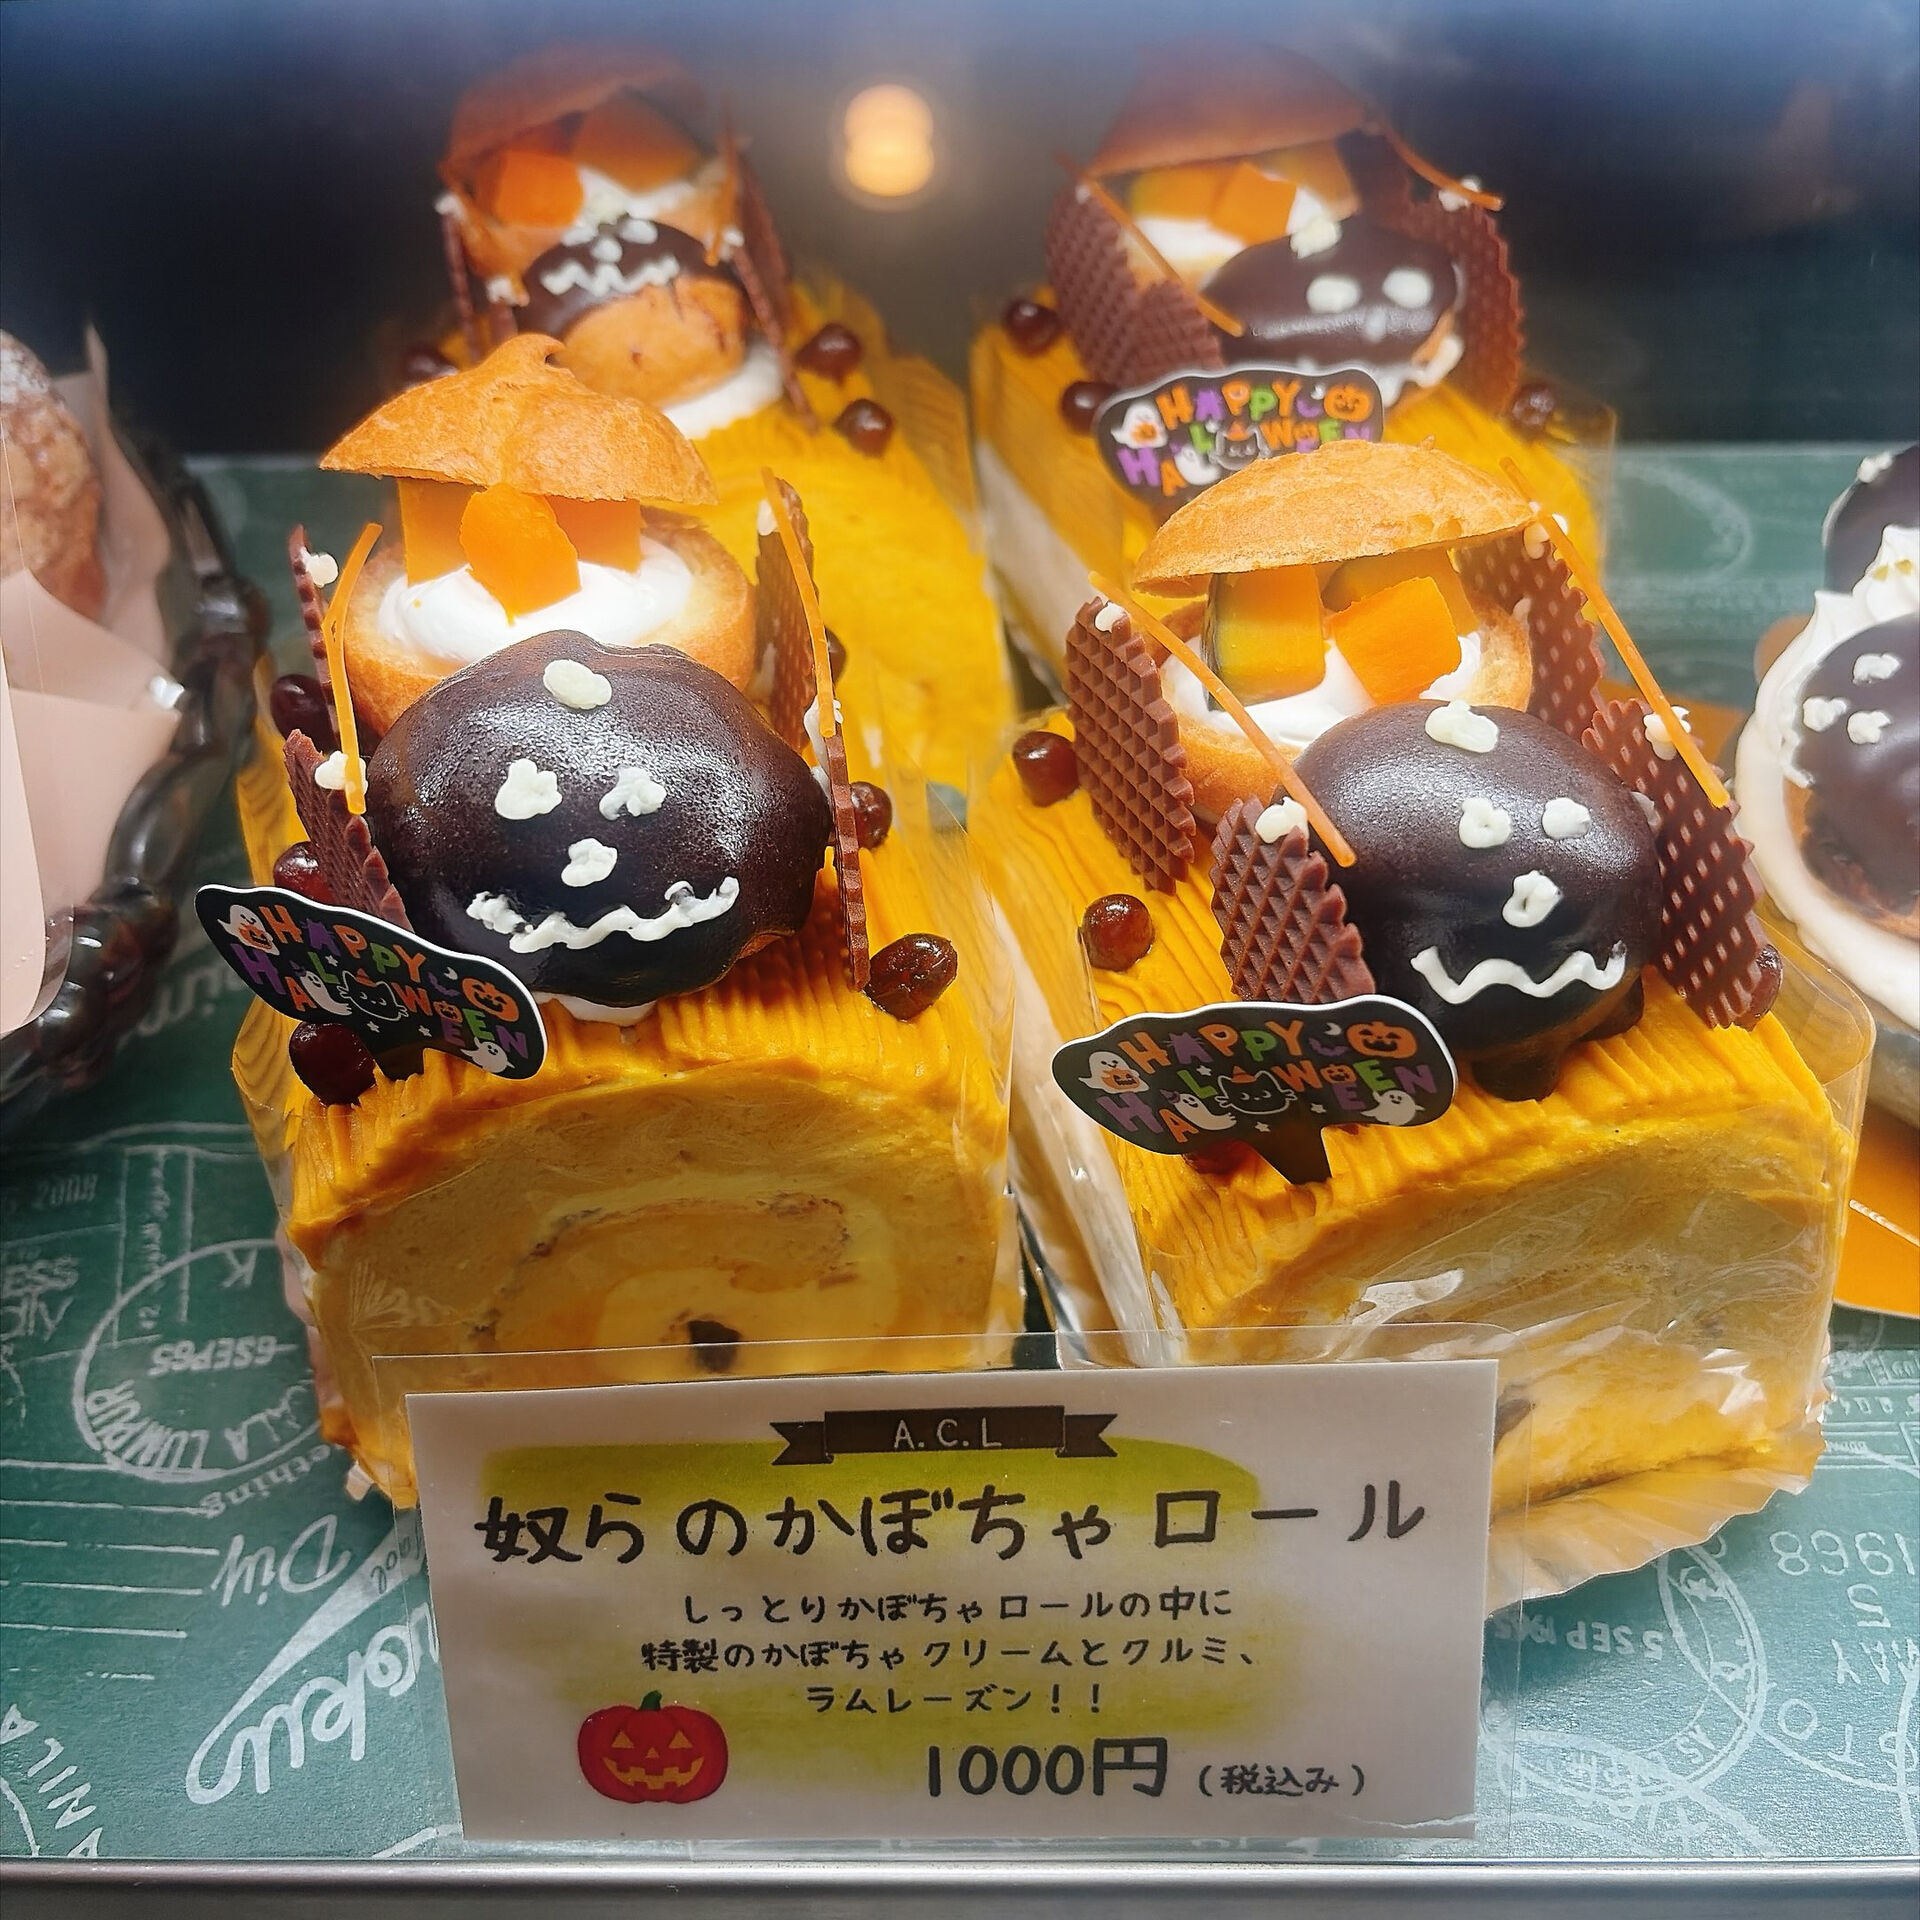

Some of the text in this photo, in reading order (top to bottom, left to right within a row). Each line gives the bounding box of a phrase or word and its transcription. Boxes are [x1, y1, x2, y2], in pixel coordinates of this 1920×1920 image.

[1156, 379, 1301, 430] HAPPY
[259, 904, 427, 983] HAPPY
[1118, 1019, 1304, 1075] HAPPY
[892, 1416, 1003, 1450] A.C.L
[474, 1480, 1426, 1565] 奴らのかぼちゃロール
[683, 1585, 1232, 1624] しっとりかぼちゃロールの中に
[641, 1636, 1255, 1674] 特製のかぼちゃクリームとクルミ、
[927, 1736, 1169, 1798] 1000円
